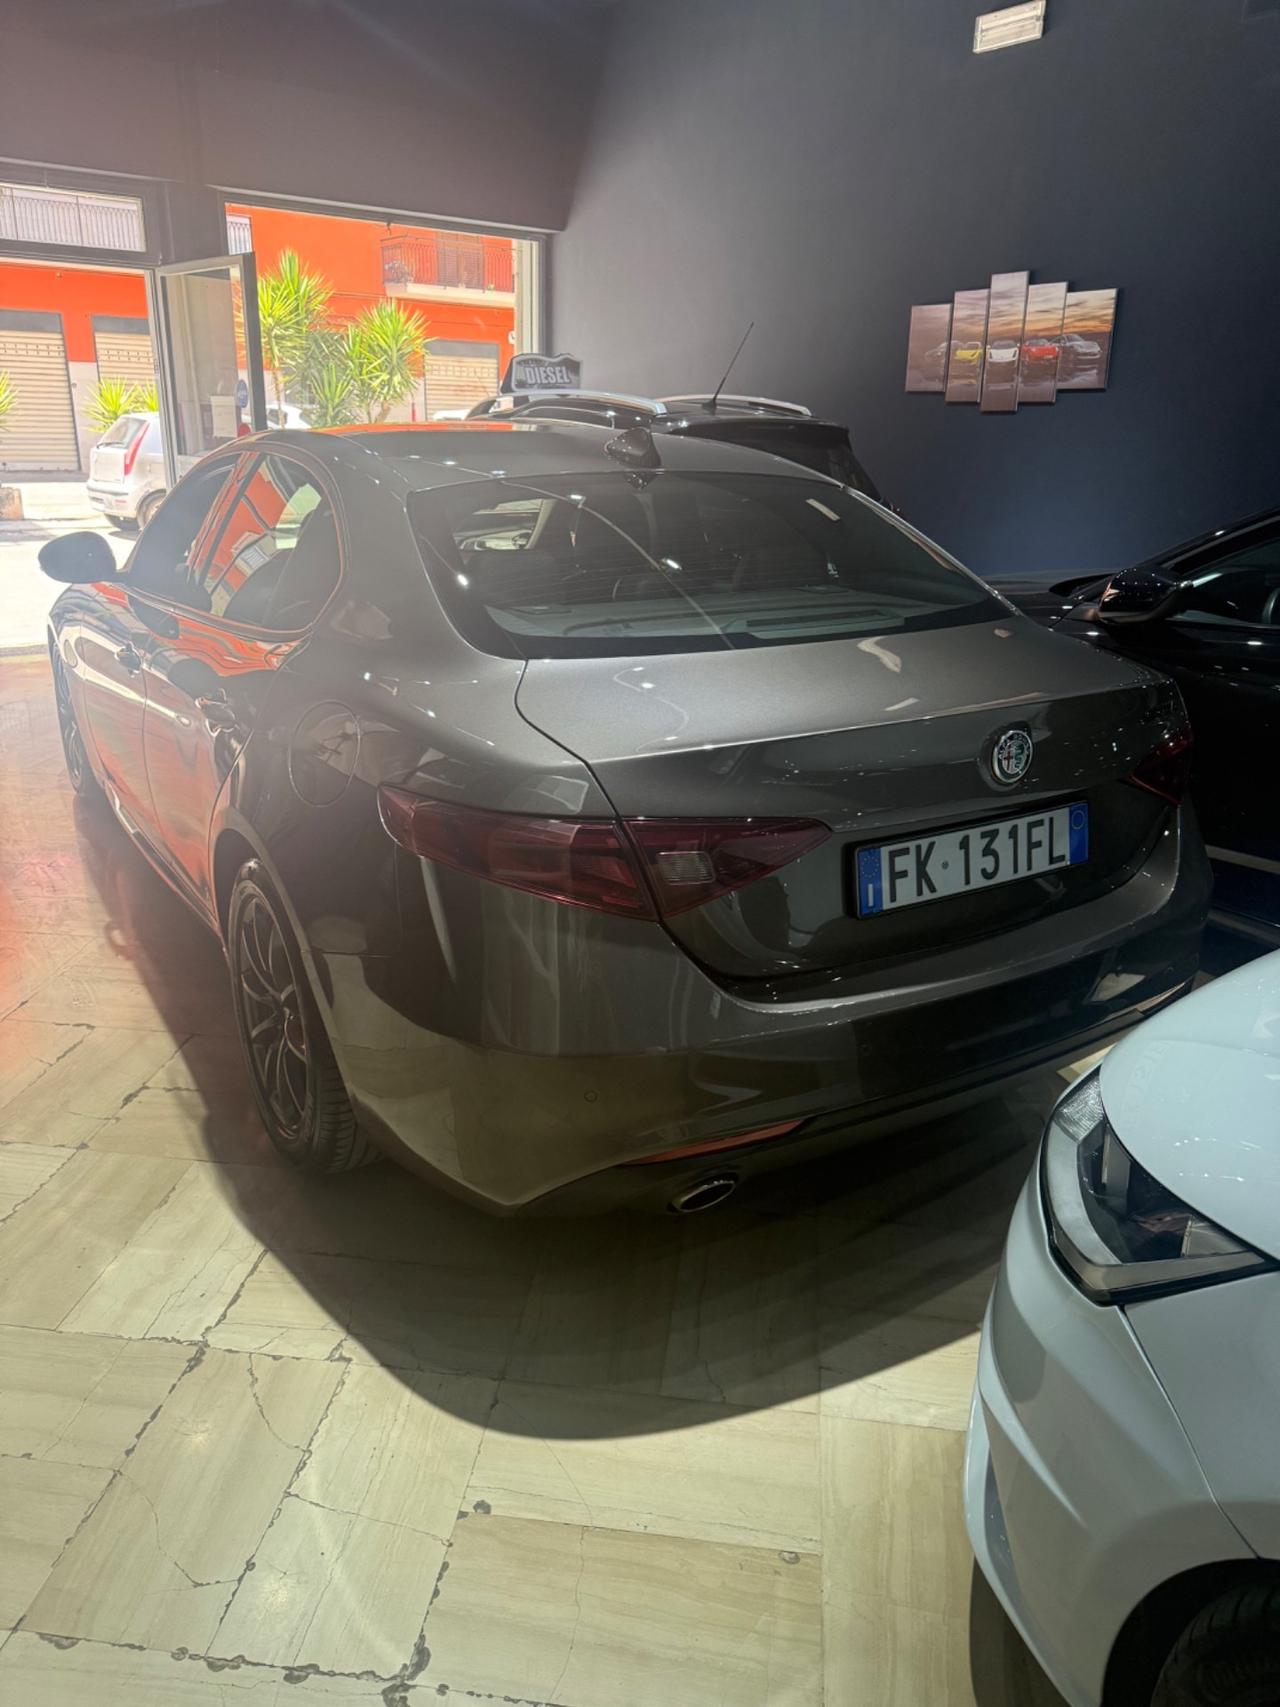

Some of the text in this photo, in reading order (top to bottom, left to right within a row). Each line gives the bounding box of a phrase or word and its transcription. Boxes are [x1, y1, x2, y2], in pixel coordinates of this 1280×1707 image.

[526, 366, 570, 384] DIESEL
[888, 816, 1066, 903] FK 131FL
